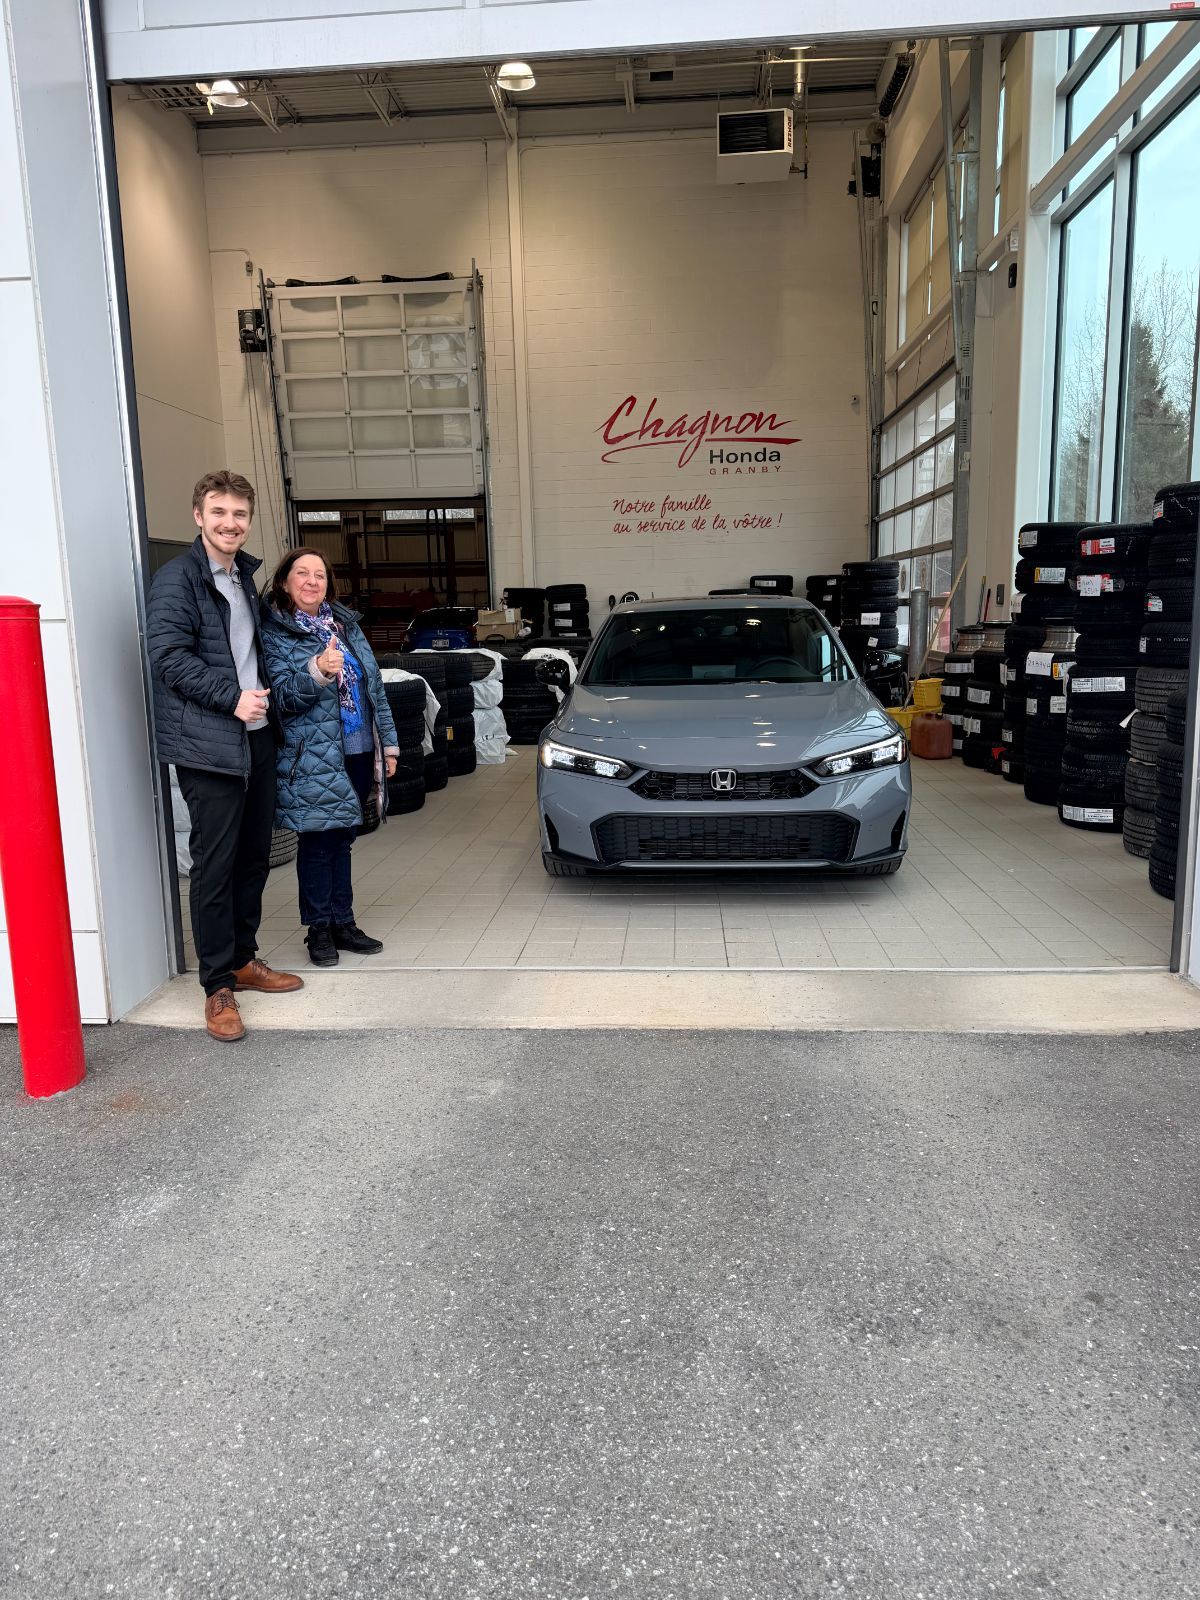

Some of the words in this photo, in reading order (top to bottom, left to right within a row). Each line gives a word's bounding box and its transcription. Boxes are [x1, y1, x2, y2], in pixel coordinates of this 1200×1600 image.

[594, 395, 802, 468] Chagnon
[709, 447, 781, 464] Honda
[709, 465, 782, 475] GRANBY
[613, 499, 656, 514] Notre
[660, 494, 712, 518] famille
[613, 522, 631, 533] au
[637, 518, 685, 532] service
[691, 515, 706, 530] de
[712, 513, 726, 530] la
[733, 513, 772, 529] vôtre
